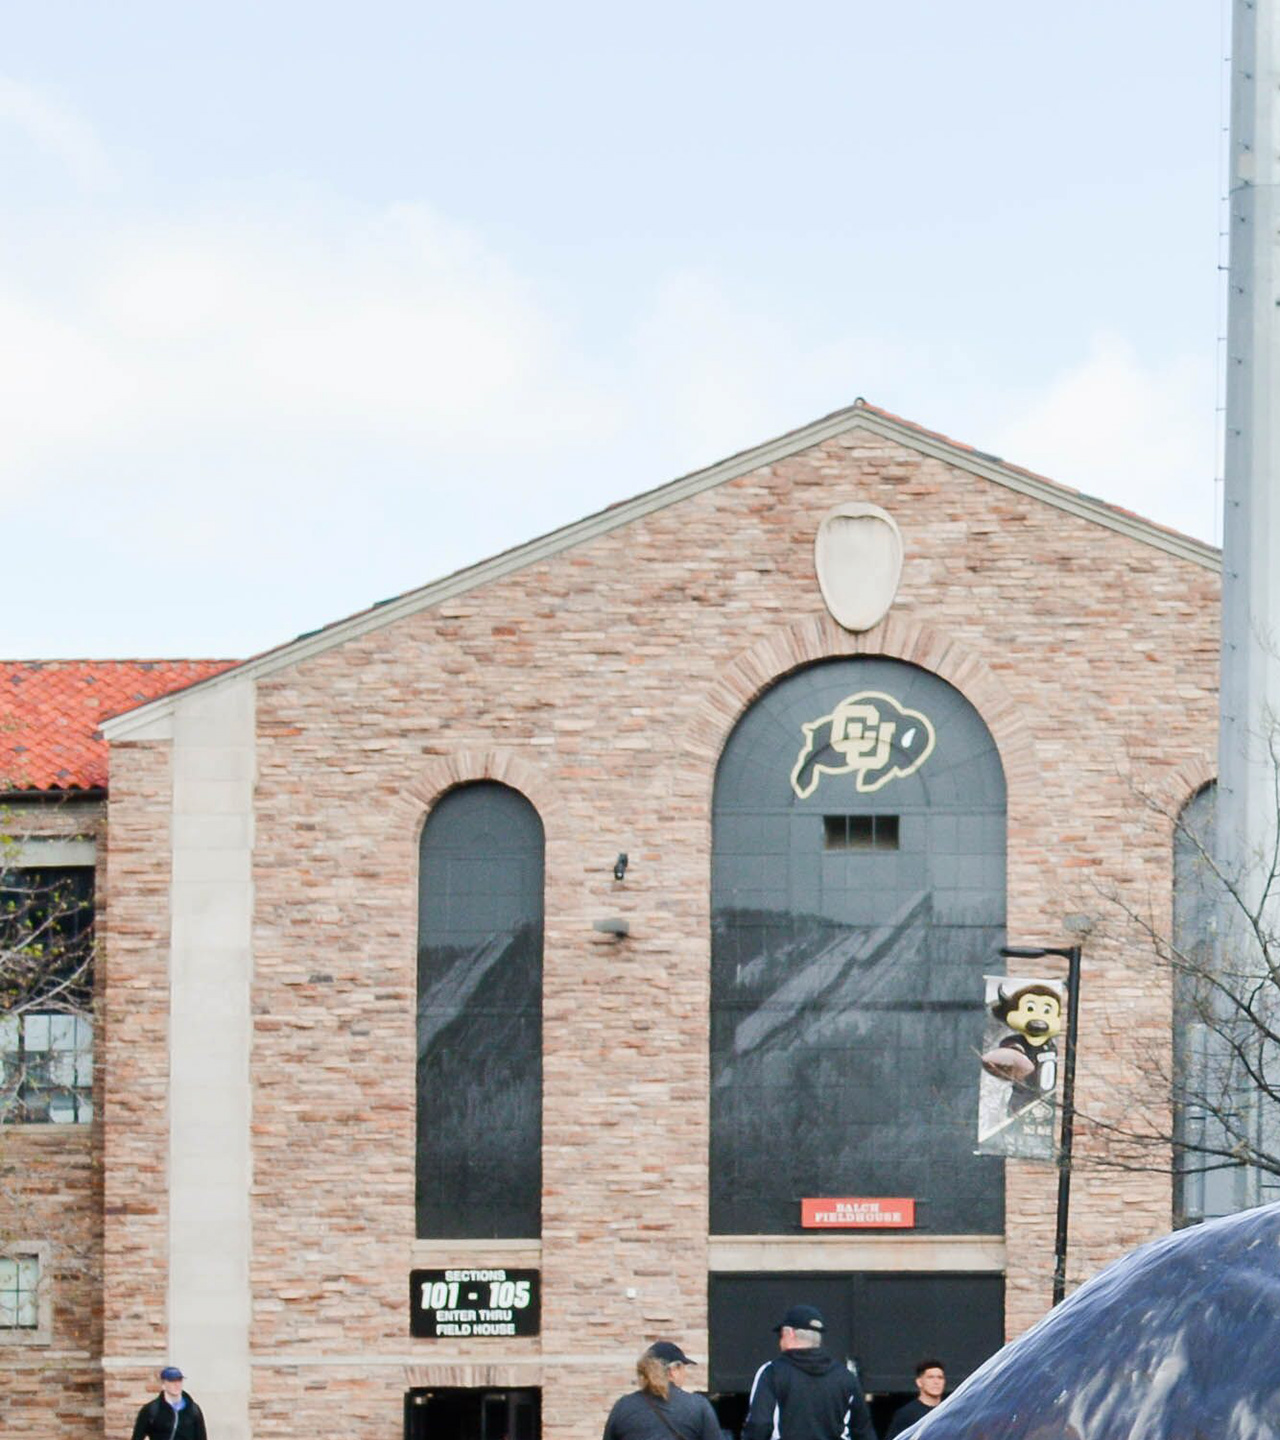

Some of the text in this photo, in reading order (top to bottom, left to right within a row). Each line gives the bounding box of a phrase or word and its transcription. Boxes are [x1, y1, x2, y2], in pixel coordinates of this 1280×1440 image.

[830, 704, 896, 770] CU
[836, 1203, 880, 1212] BALCH
[815, 1212, 903, 1222] FIELDHOUSE
[445, 1269, 506, 1281] SECTIONS
[421, 1282, 459, 1309] 101
[489, 1281, 531, 1308] 105
[436, 1309, 512, 1322] ENTER THRU
[436, 1323, 516, 1335] FIELD HOUSE
